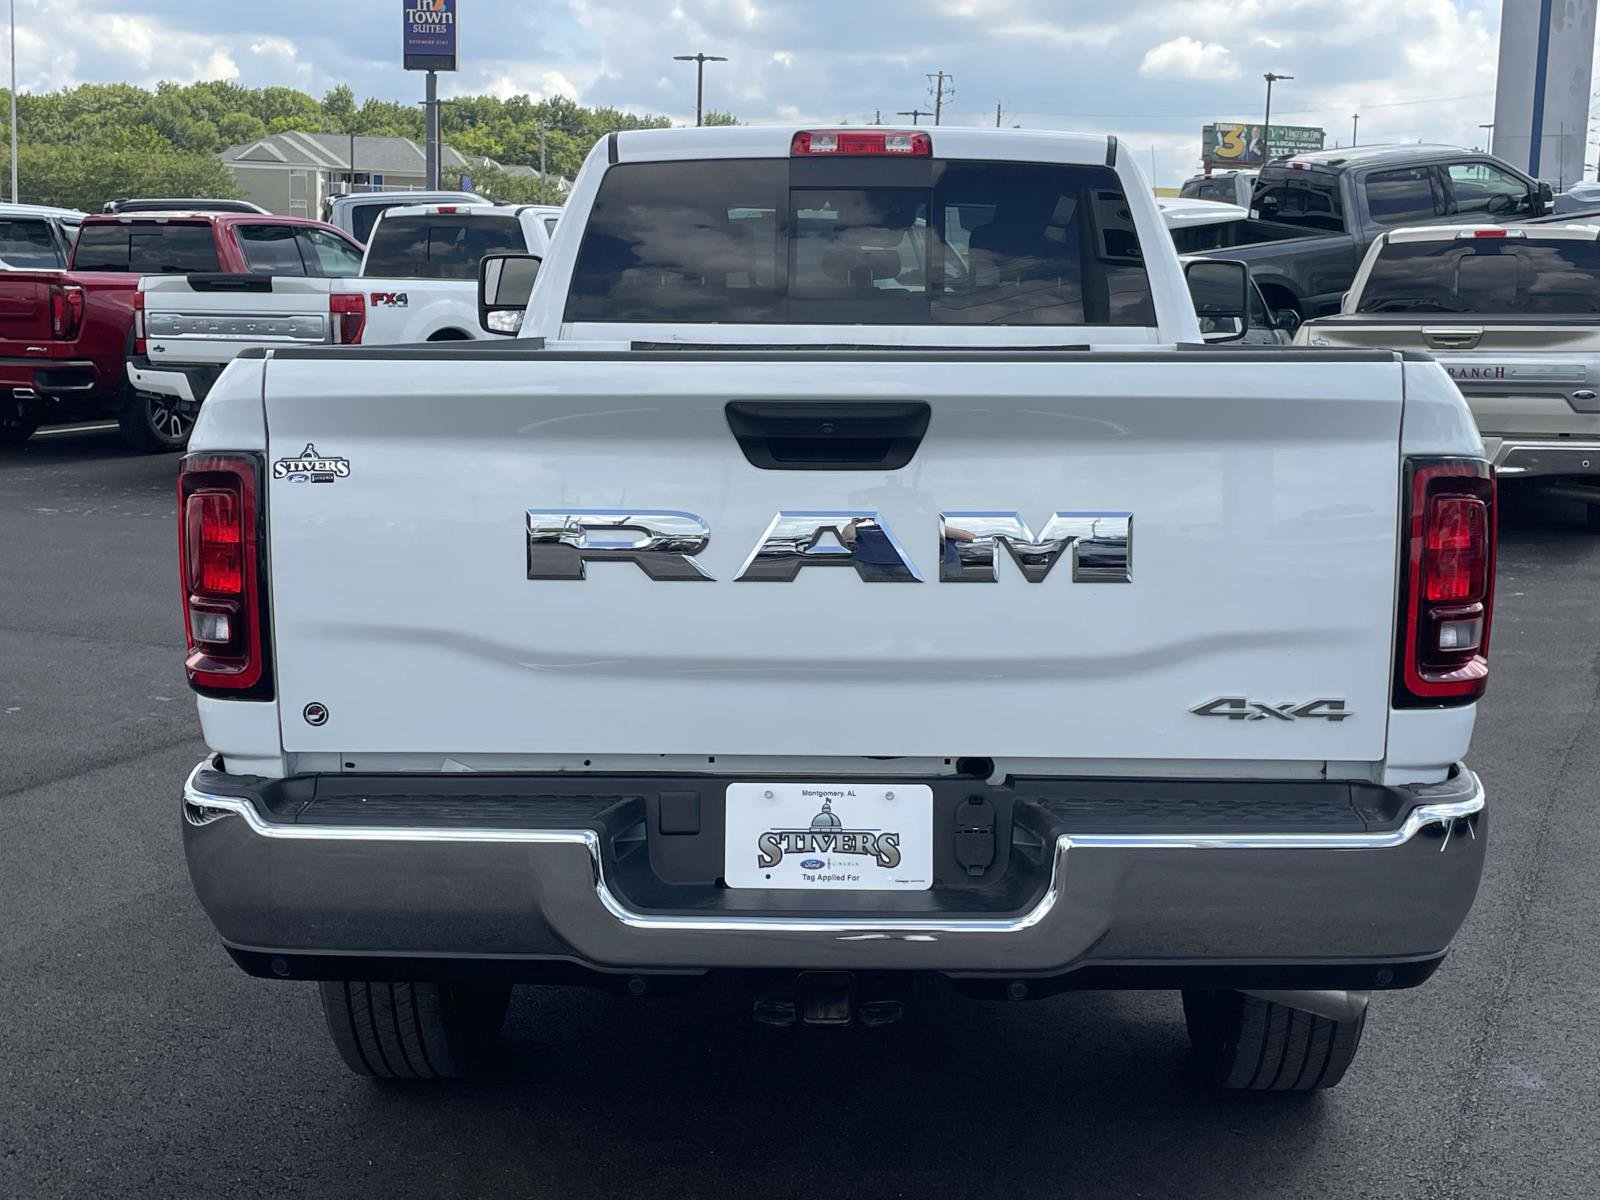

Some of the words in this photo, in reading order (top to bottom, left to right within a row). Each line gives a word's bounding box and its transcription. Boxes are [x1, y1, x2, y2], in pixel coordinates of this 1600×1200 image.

[406, 9, 453, 23] Town
[412, 24, 446, 33] SUITES
[370, 293, 408, 307] FX4
[1448, 367, 1505, 379] RANCH
[273, 459, 351, 479] STIVERS
[525, 509, 1135, 583] RAM
[802, 789, 845, 798] Montgomery,
[757, 831, 901, 869] STIVERS
[802, 860, 823, 869] Ford
[802, 874, 816, 882] Tag
[818, 874, 845, 882] Applied
